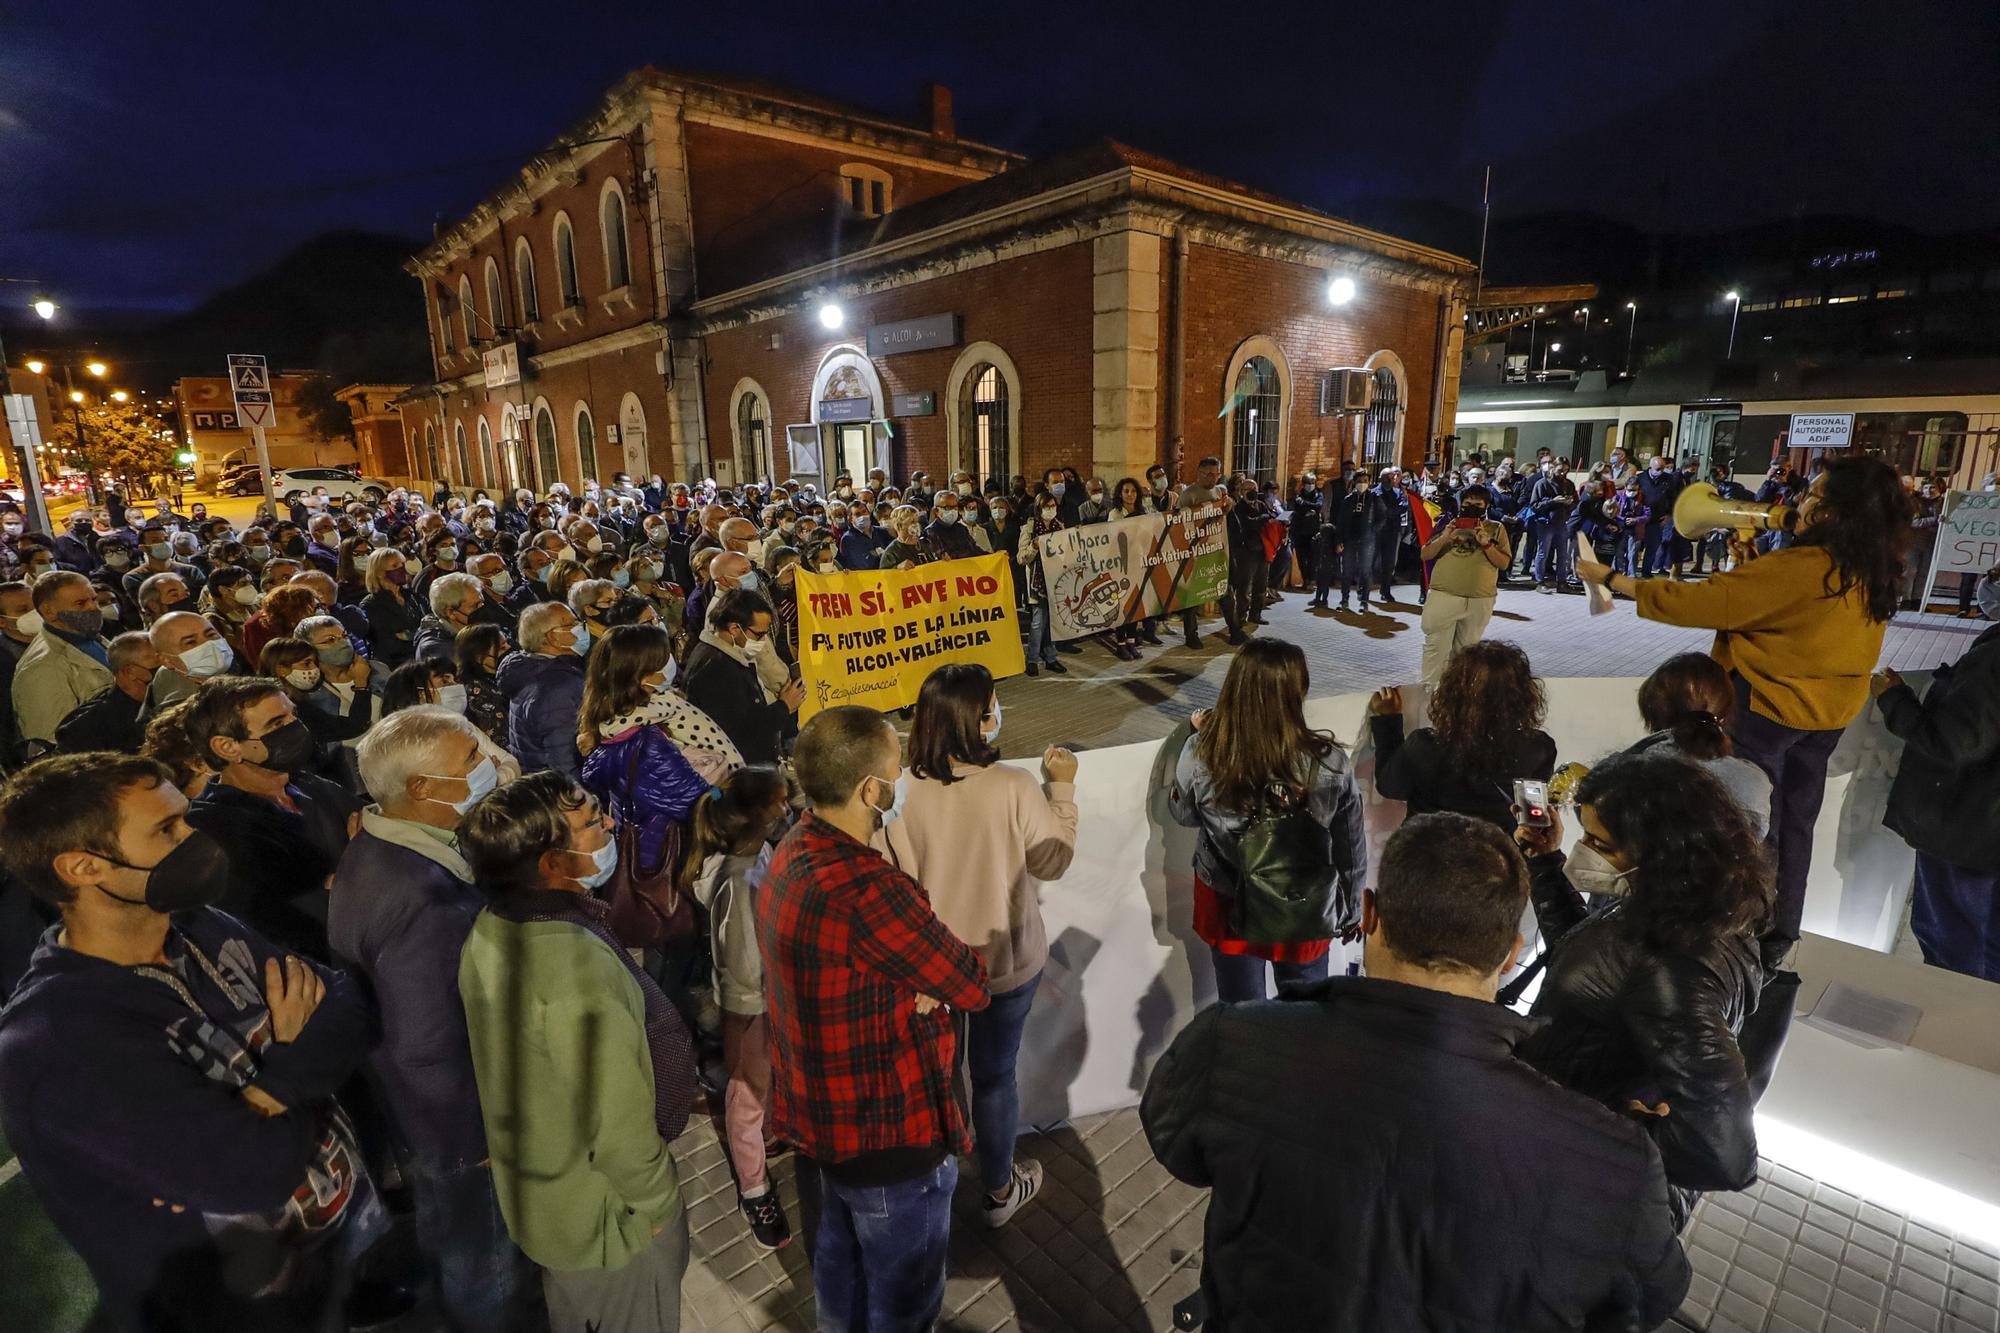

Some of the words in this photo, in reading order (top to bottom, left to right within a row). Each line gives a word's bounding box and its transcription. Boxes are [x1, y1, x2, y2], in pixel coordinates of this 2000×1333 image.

[1797, 418, 1847, 426] PERSONAL
[1795, 427, 1848, 435] AUTORIZADO
[1167, 513, 1182, 526] Per
[1193, 507, 1223, 521] millora
[1185, 528, 1196, 540] de
[1196, 526, 1205, 538] la
[1953, 521, 2000, 537] VEG
[1068, 531, 1110, 552] l'hora
[1076, 550, 1090, 562] del
[809, 593, 853, 619] TREN
[901, 579, 948, 609] AVE
[956, 575, 999, 598] NO
[838, 628, 887, 650] FUTUR
[893, 621, 919, 641] DE
[925, 615, 945, 634] LA
[950, 606, 1005, 627] LÍNIA
[846, 630, 992, 675] ALCOI-VALÈNCIA
